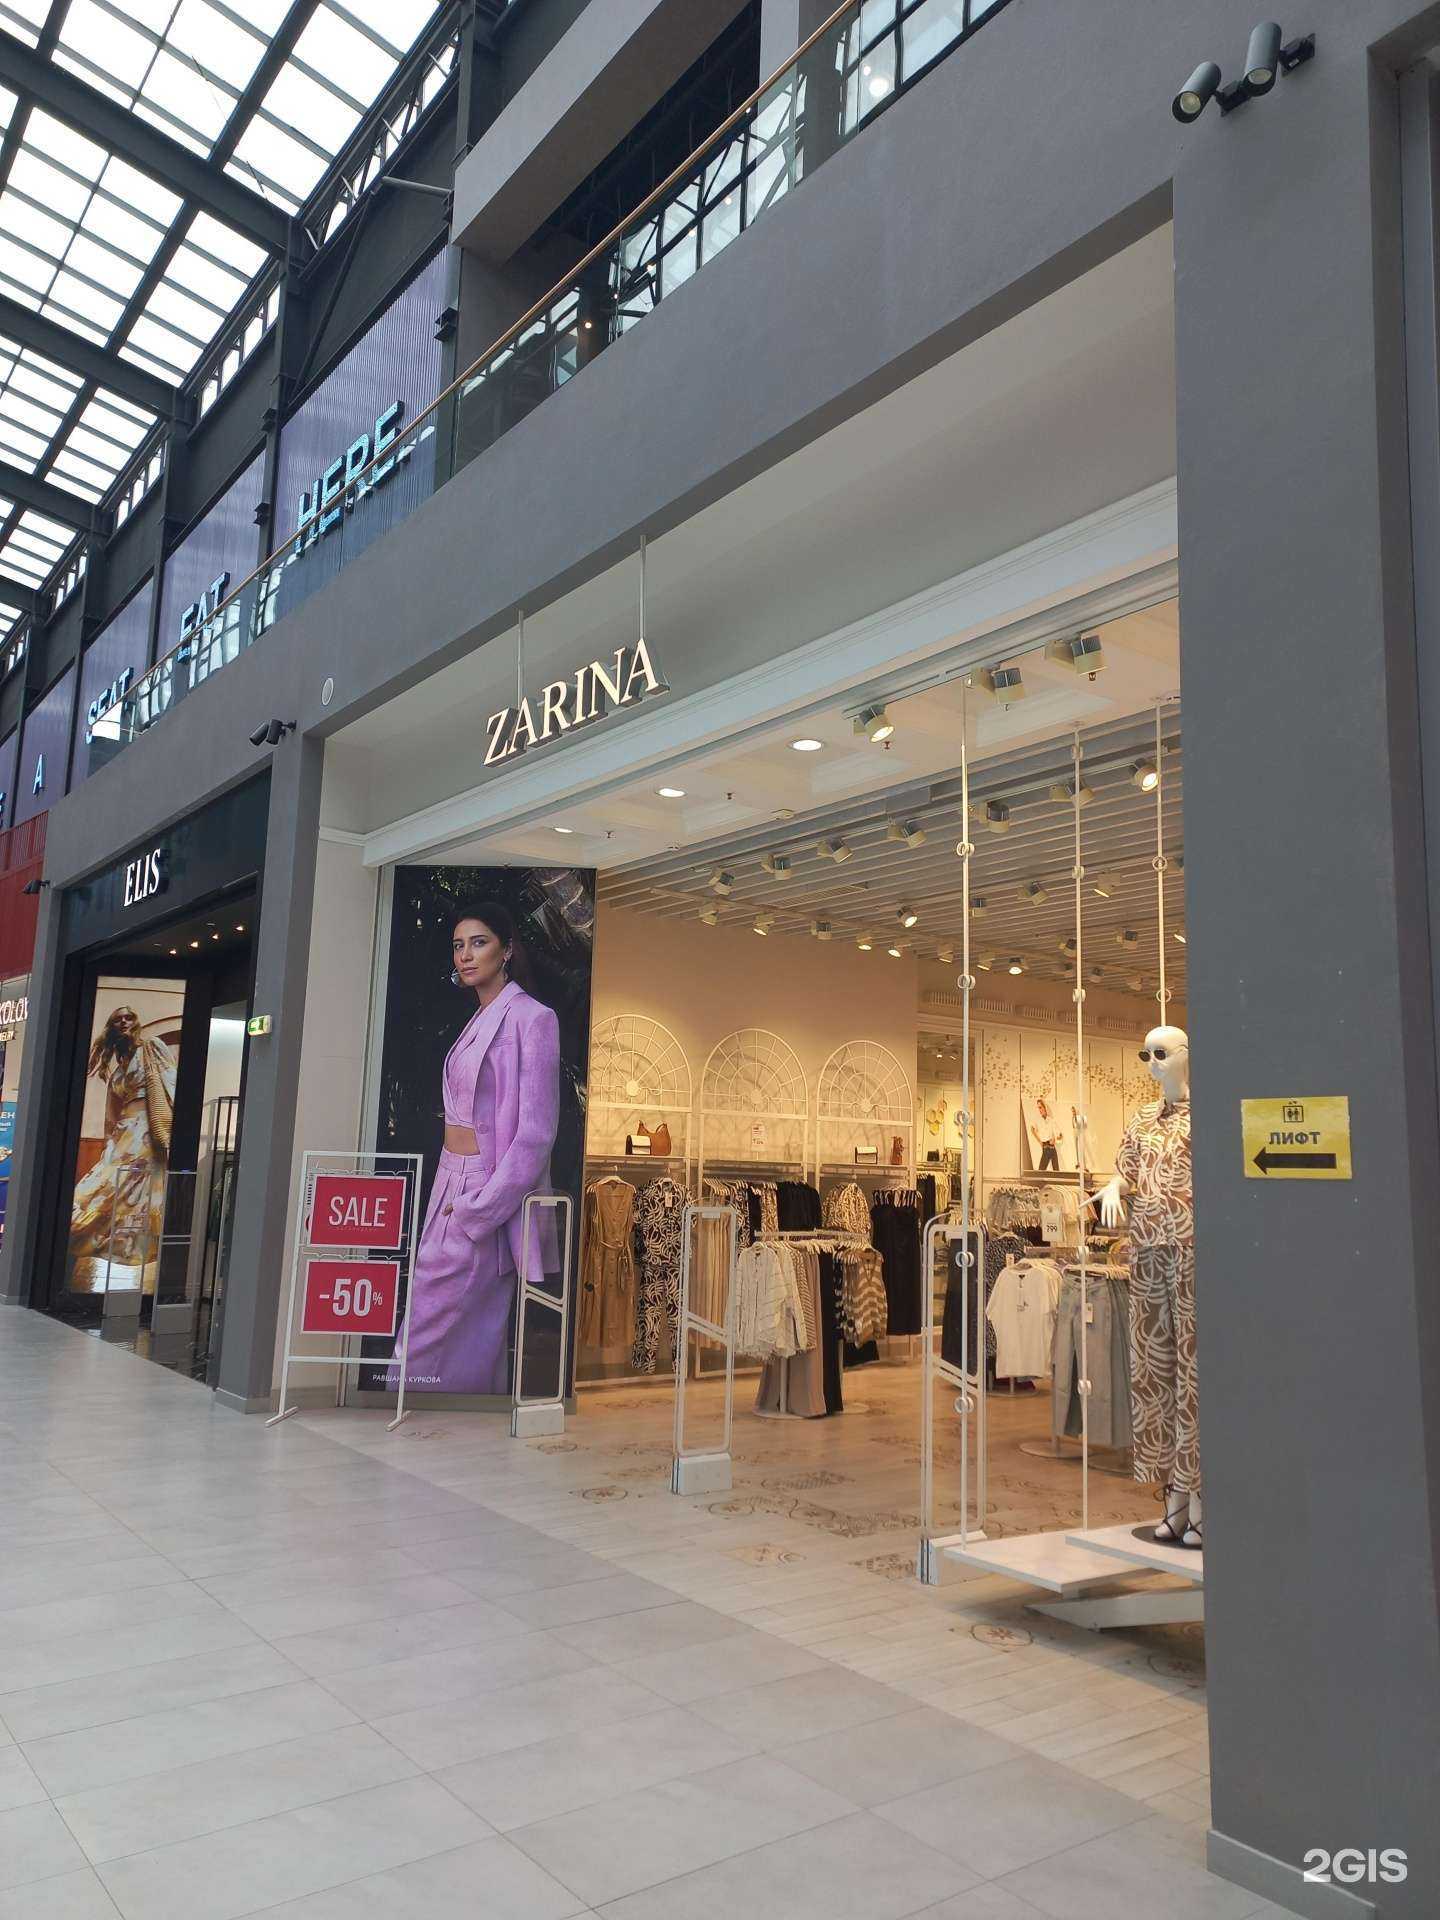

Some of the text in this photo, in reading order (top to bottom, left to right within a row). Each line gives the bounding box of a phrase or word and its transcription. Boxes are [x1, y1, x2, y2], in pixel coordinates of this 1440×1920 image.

[32, 753, 43, 794] A
[294, 400, 405, 553] HERE
[483, 637, 663, 766] ZARINA
[123, 848, 161, 907] ELIS
[1269, 1131, 1321, 1145] ЛИФТ
[328, 1195, 388, 1228] SALE
[319, 1278, 384, 1317] -50%
[408, 1375, 441, 1384] КУРКОВА
